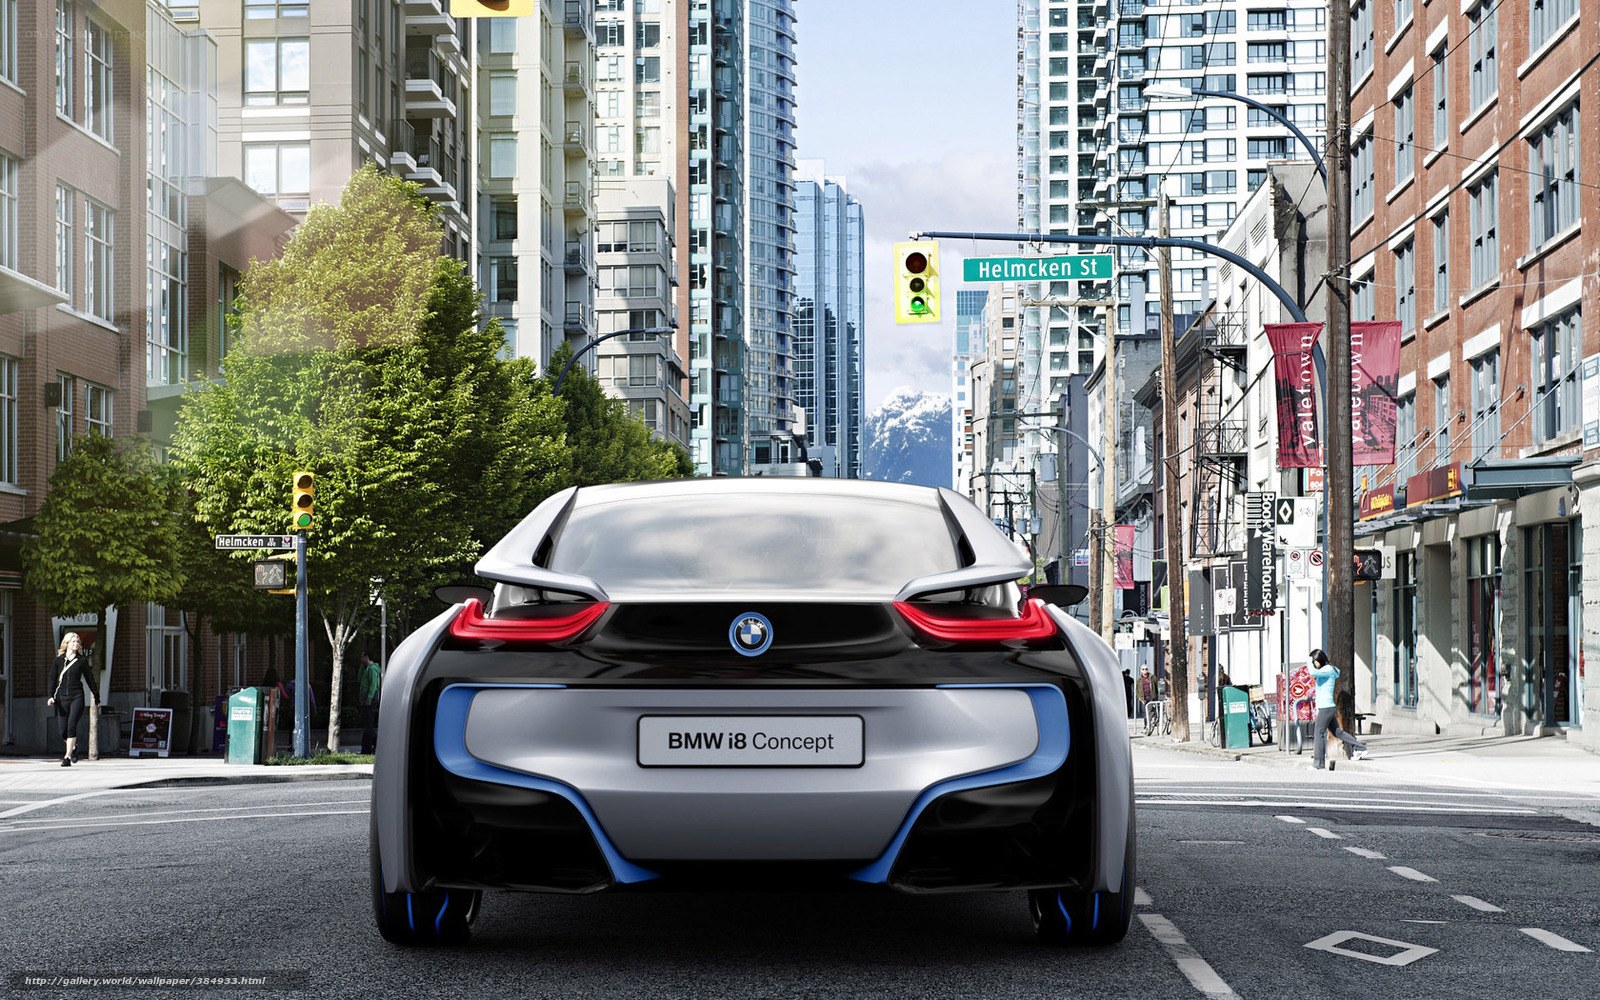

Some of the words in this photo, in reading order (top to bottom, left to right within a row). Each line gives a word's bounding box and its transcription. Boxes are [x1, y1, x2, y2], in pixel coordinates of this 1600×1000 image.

[978, 259, 1072, 278] Helmcken
[1080, 258, 1098, 276] St
[1261, 492, 1275, 529] Book
[218, 537, 264, 547] Helmcken
[1261, 531, 1275, 609] Warehouse
[738, 618, 765, 629] BMW
[668, 732, 723, 750] BMW
[728, 732, 747, 750] i8
[752, 732, 834, 753] Concept
